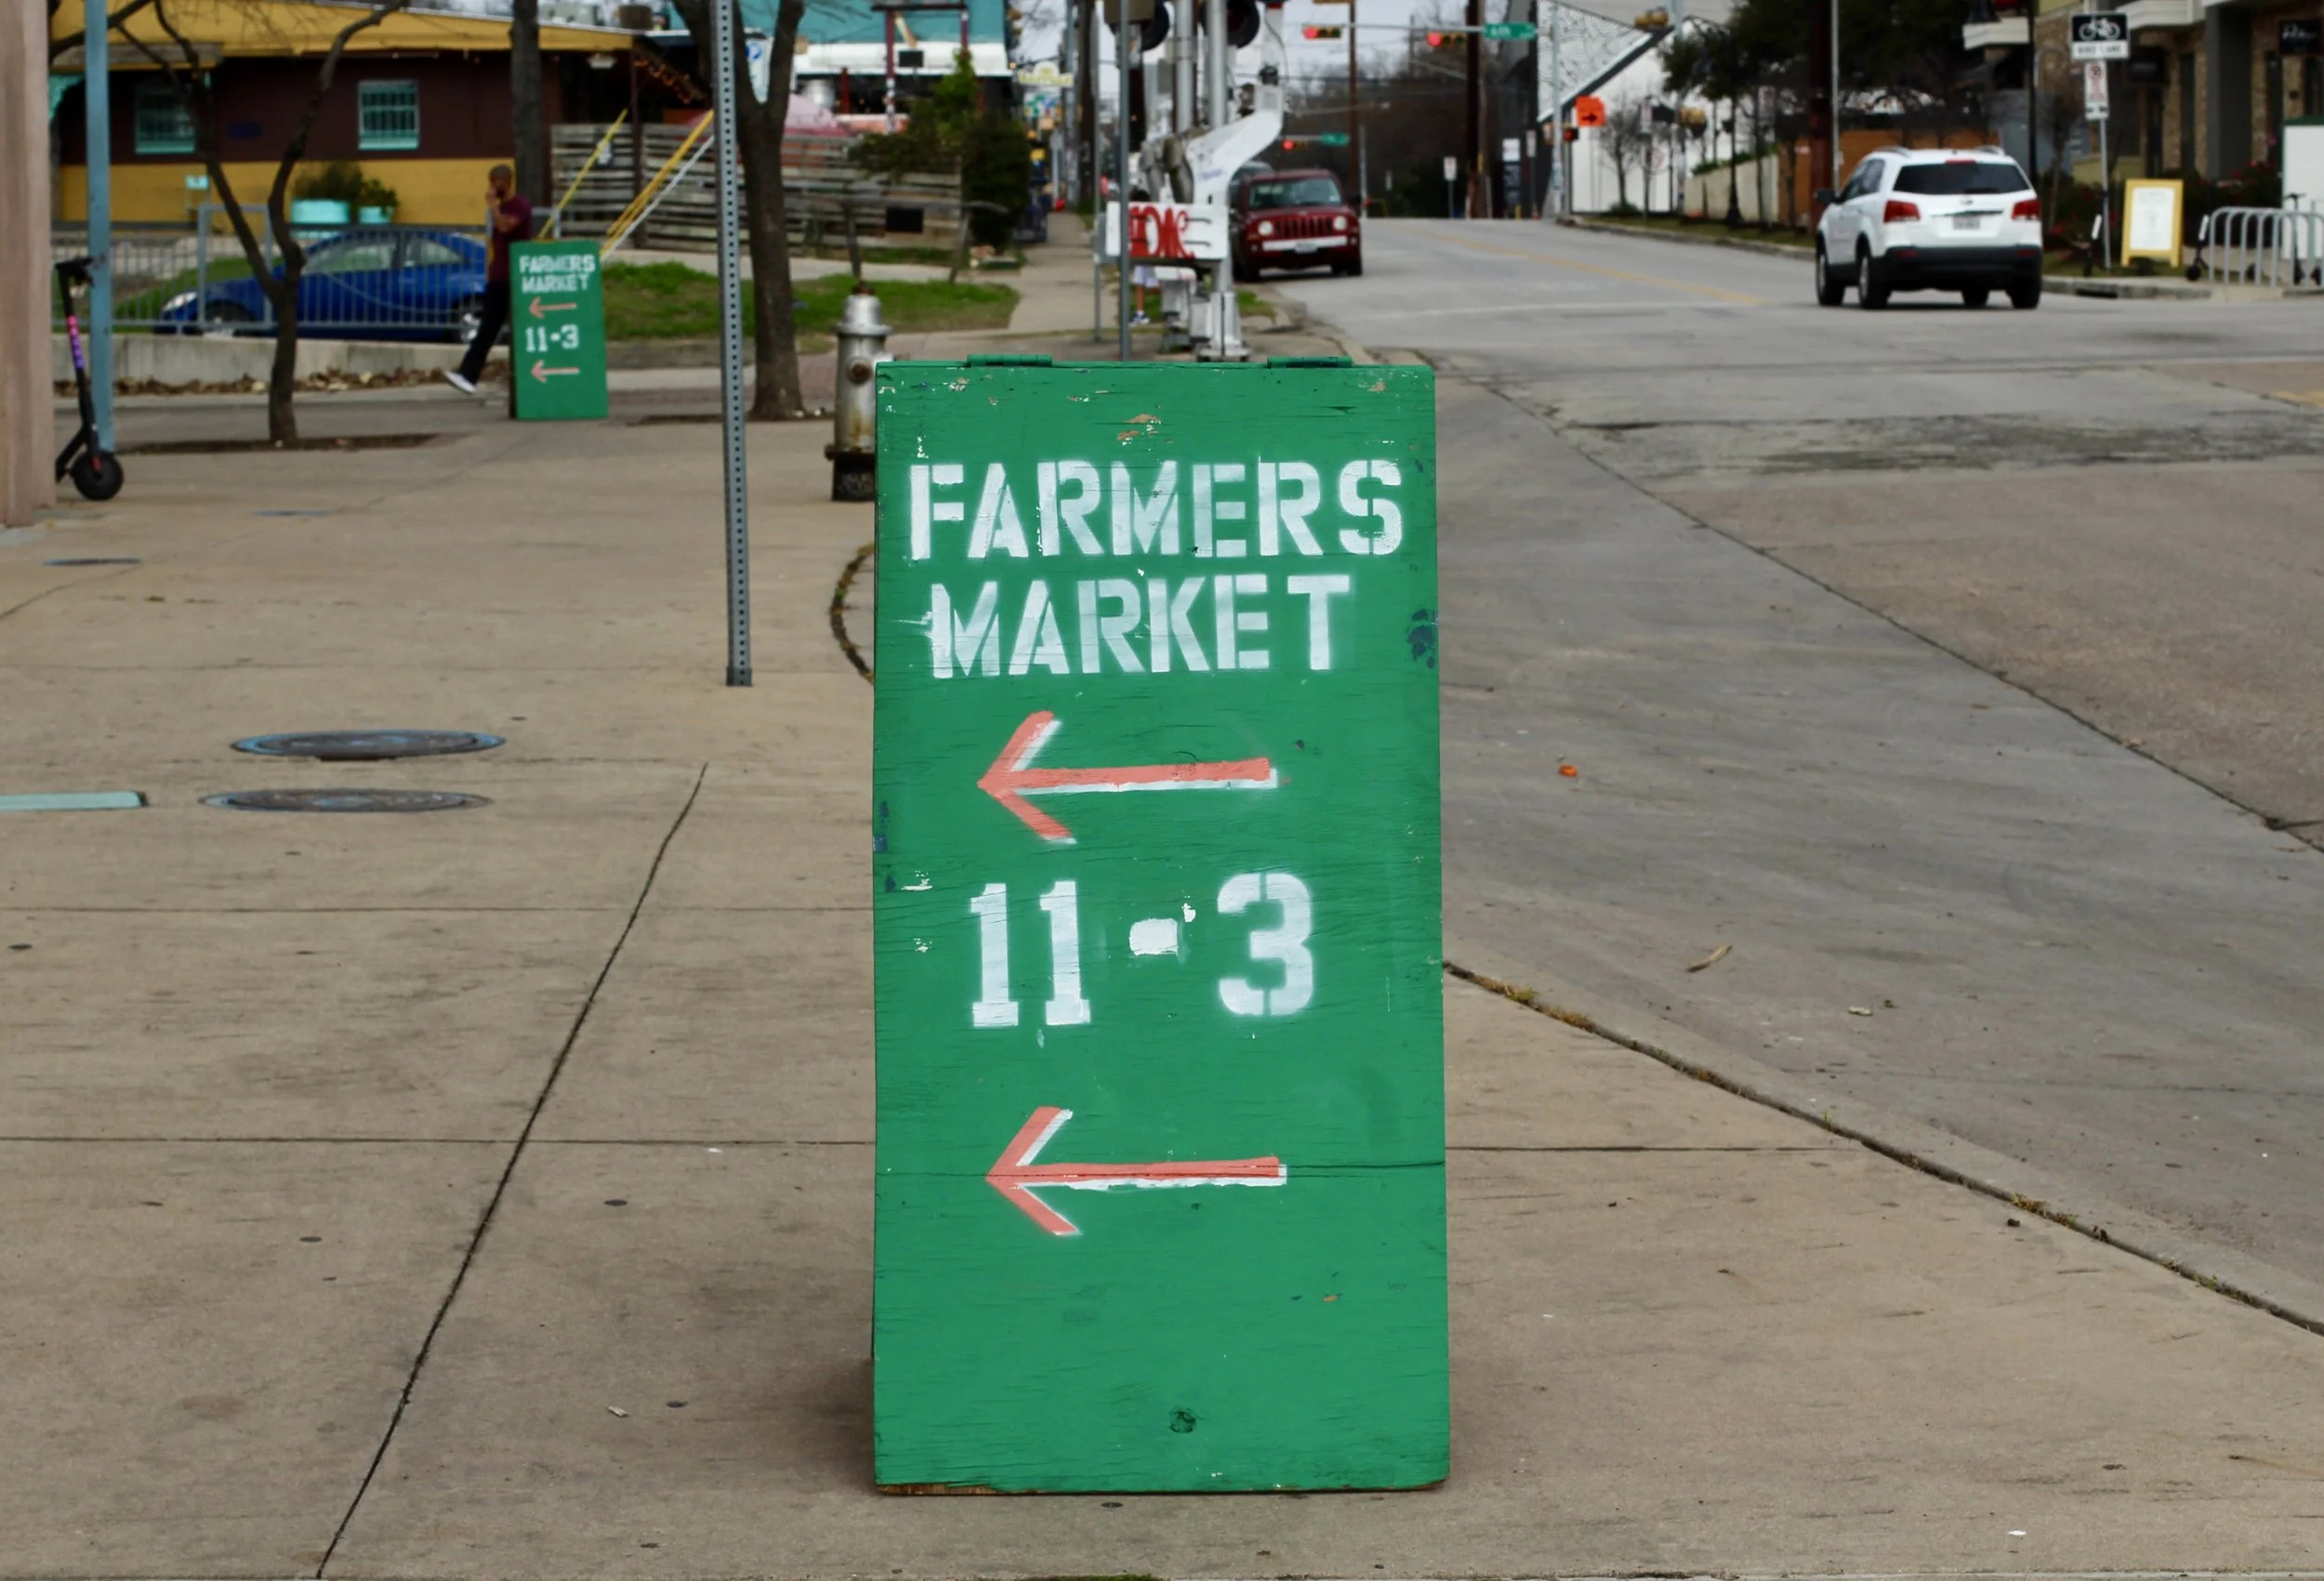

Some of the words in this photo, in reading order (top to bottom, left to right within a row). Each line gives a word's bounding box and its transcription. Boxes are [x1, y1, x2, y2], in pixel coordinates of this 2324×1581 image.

[519, 254, 596, 274] FARMERS
[522, 274, 589, 293] MARKET
[525, 323, 579, 353] 11-3
[909, 459, 1403, 560] FARMERS
[931, 573, 1351, 679] MARKET
